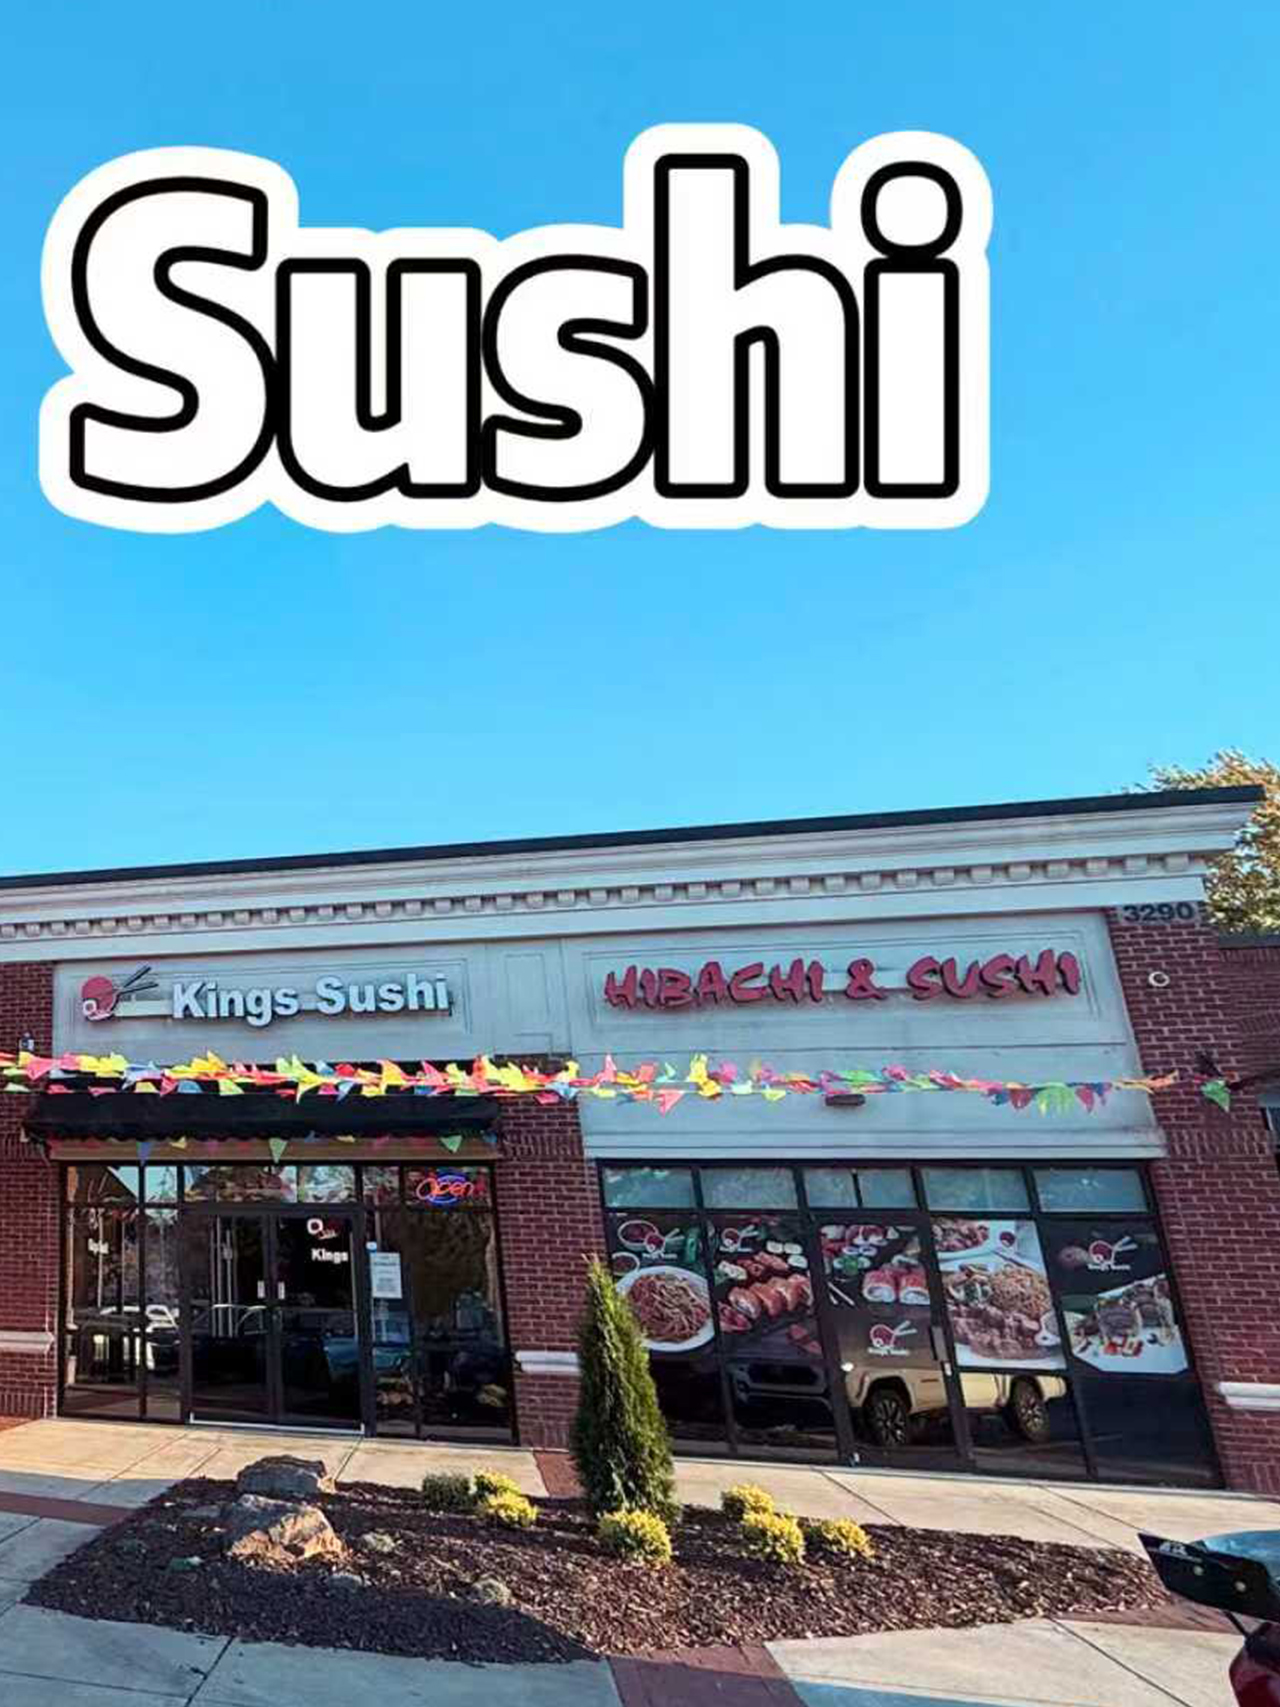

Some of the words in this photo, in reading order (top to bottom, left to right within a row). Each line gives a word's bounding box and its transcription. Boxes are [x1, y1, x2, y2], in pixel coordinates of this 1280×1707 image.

[1122, 902, 1195, 921] 3290
[171, 980, 300, 1027] Kings
[315, 973, 450, 1015] Sushi
[604, 961, 826, 1008] HIBACHI
[845, 957, 889, 1001] &
[906, 948, 1081, 1000] SUSHI
